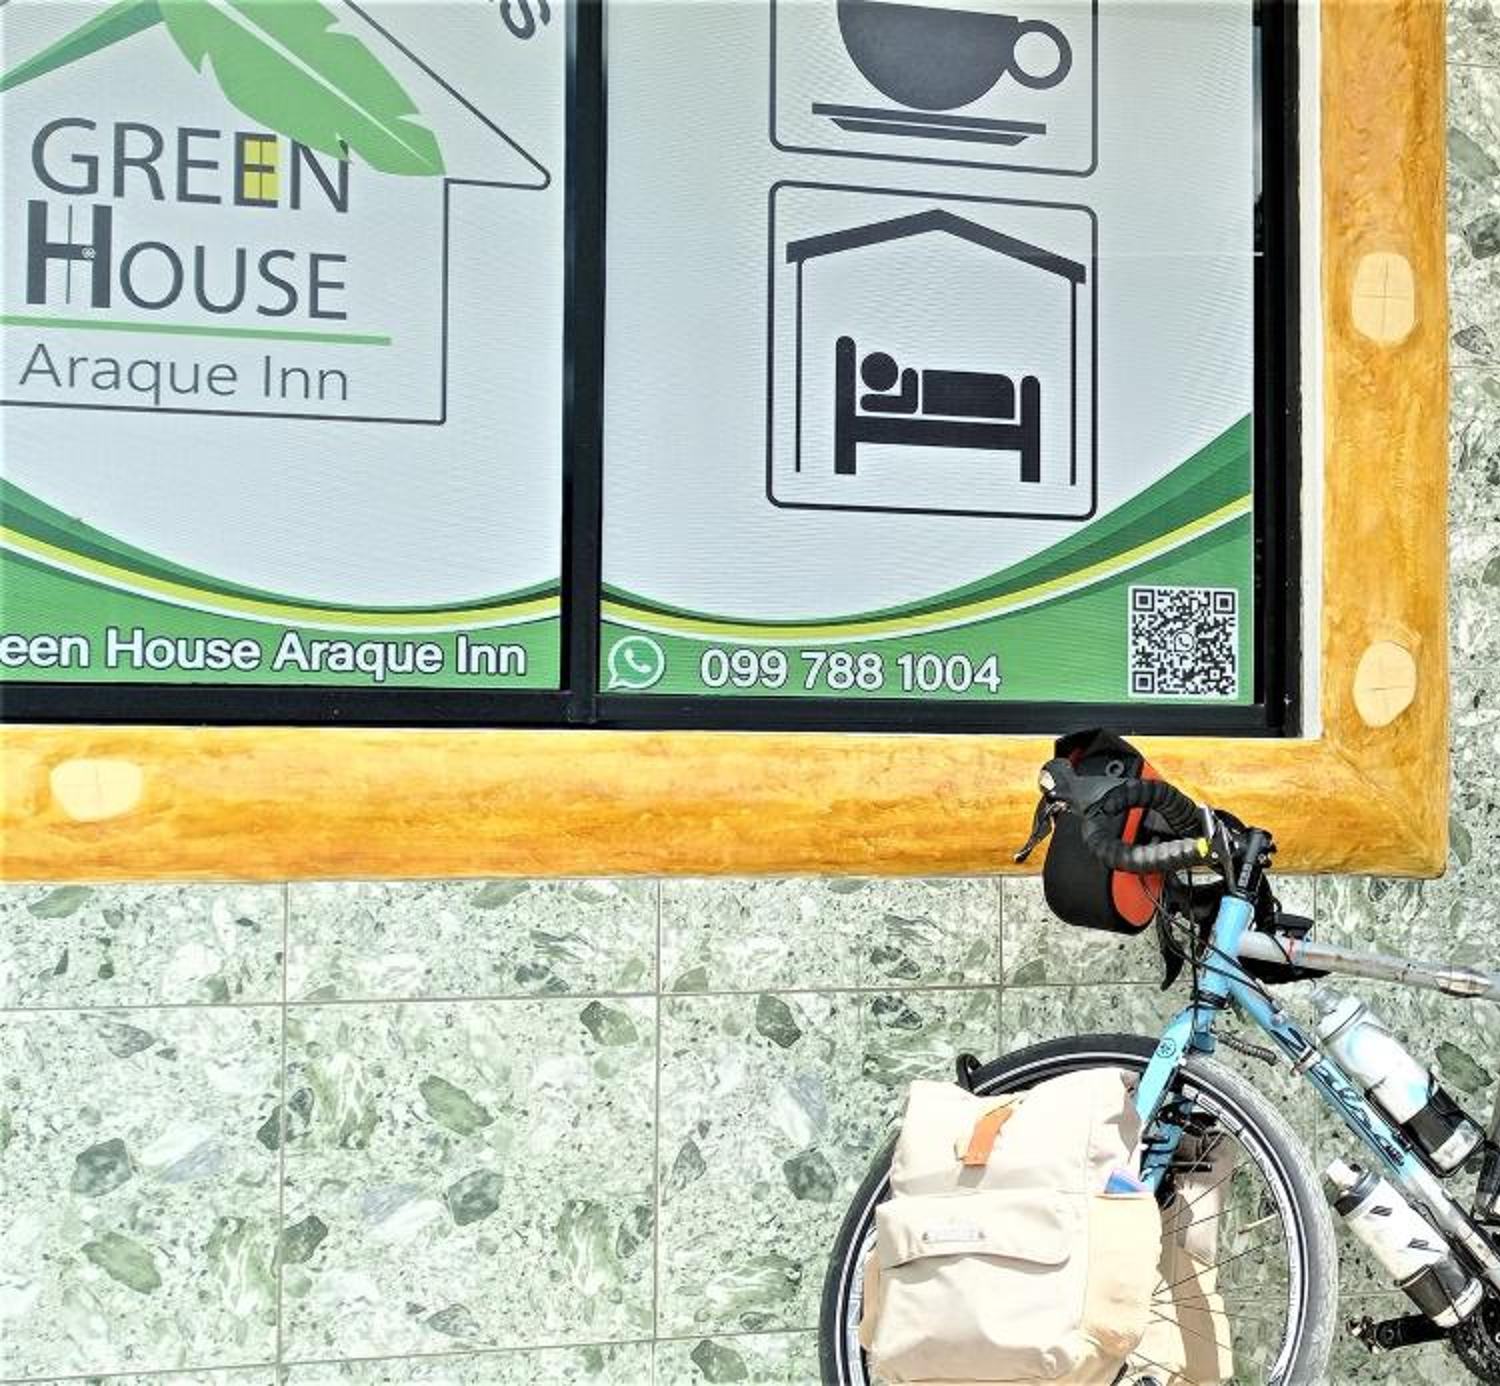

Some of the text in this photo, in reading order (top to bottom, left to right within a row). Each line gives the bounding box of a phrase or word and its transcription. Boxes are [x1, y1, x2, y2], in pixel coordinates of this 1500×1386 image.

[31, 116, 349, 213] GREEN
[26, 199, 348, 321] HOUSE
[19, 342, 349, 405] Araque Inn
[0, 627, 527, 682] een House Araque Inn
[699, 648, 1001, 694] 099 788 1004
